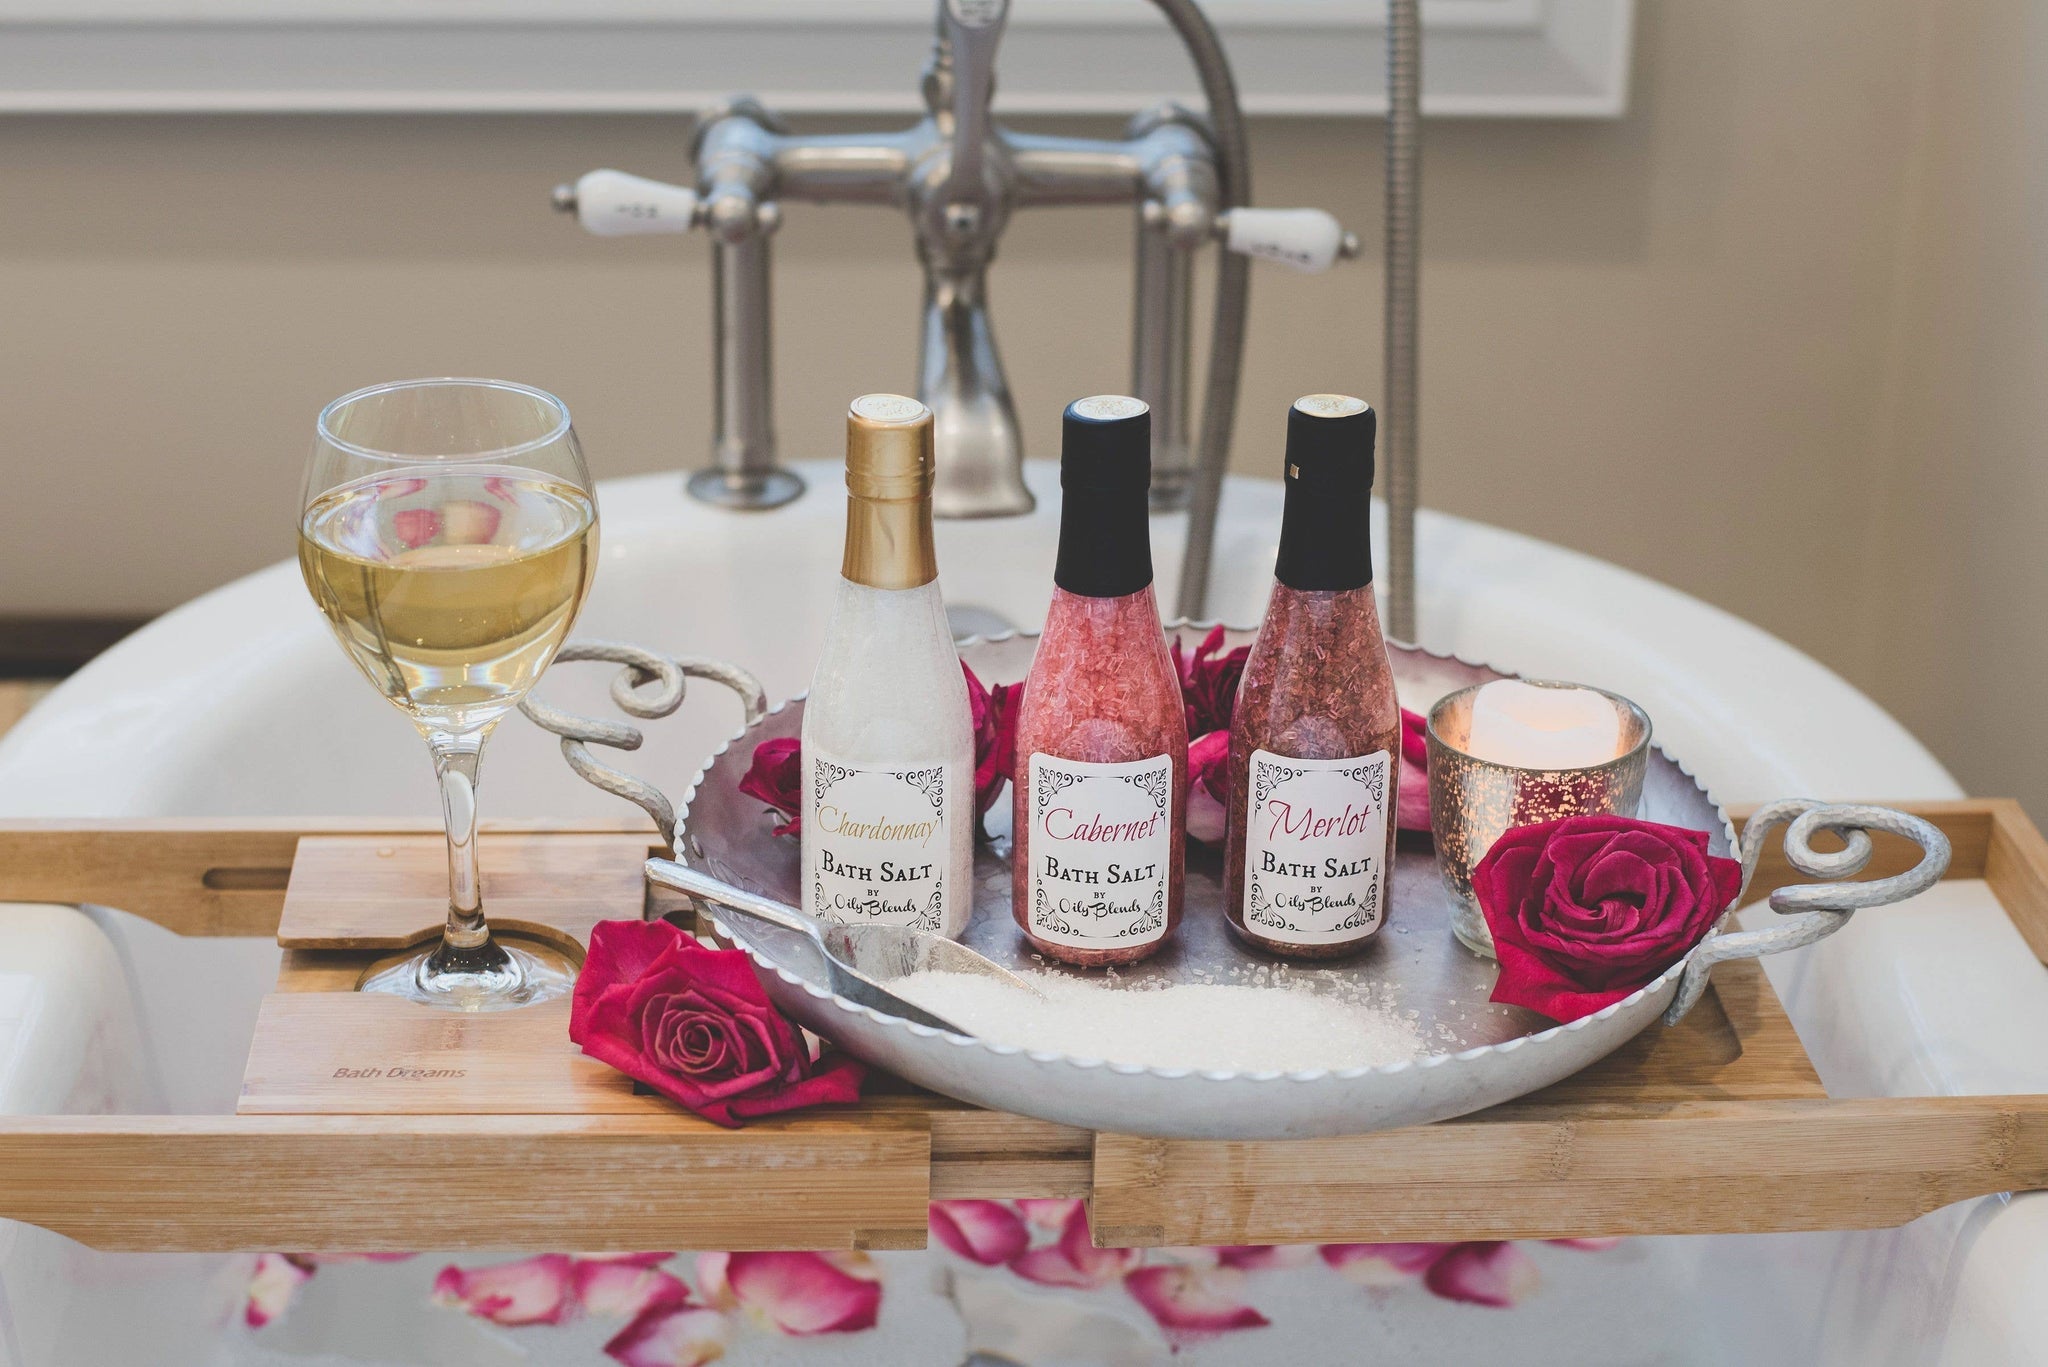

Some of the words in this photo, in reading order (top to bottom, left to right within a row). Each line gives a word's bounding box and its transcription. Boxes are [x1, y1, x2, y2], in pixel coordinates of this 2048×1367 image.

[818, 805, 938, 848] Chardonnay
[1045, 808, 1159, 842] Cabernet
[1268, 800, 1372, 841] Merlot
[867, 889, 879, 897] BY
[1093, 891, 1106, 899] BY
[332, 1067, 382, 1079] Bath
[386, 1067, 468, 1079] Dreams
